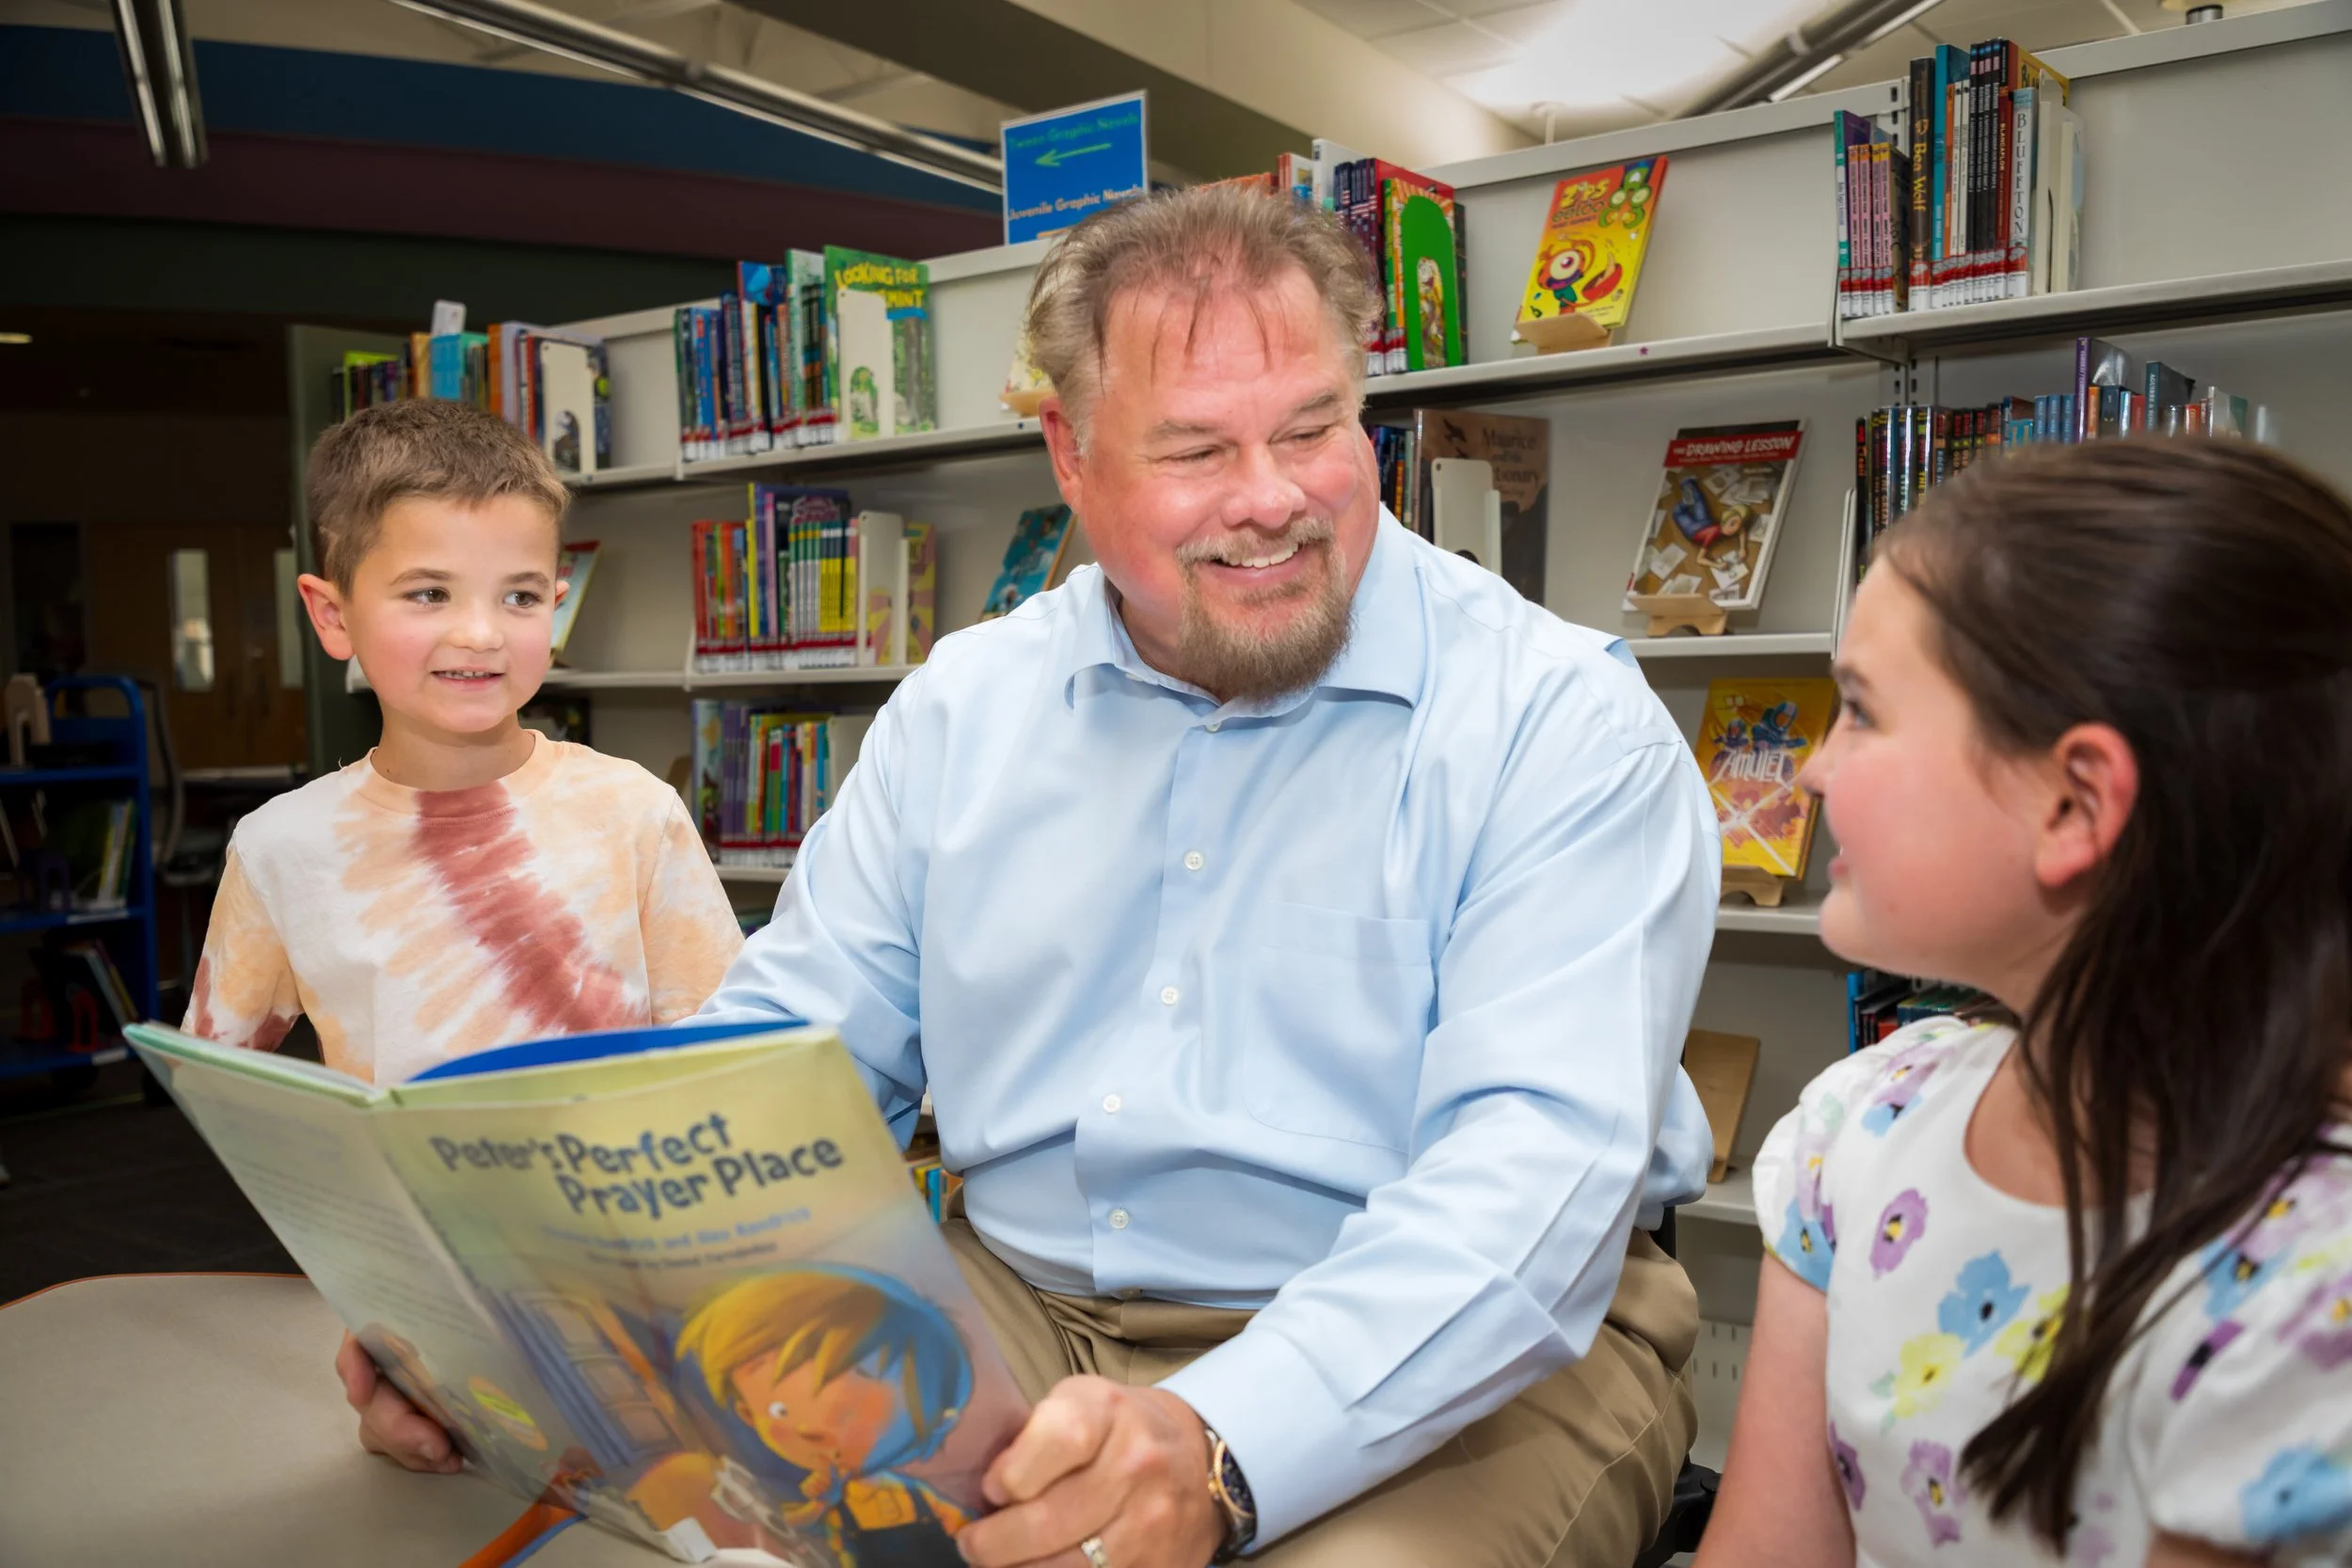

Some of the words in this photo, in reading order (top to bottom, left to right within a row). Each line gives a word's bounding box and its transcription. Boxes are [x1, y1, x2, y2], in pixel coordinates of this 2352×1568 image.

[1047, 122, 1095, 141] Graphic
[1097, 112, 1139, 130] Novels
[1914, 142, 1927, 171] Bea
[2014, 113, 2027, 234] BLUFFTON
[1009, 202, 1053, 221] Juvenile
[1055, 193, 1101, 212] Graphic
[1913, 176, 1927, 212] Wolf
[834, 261, 894, 290] LOOKING
[896, 266, 919, 284] FOR
[1686, 439, 1742, 457] DRAWING
[1744, 436, 1795, 452] LESSON
[429, 1134, 563, 1172] Peter's
[557, 1113, 731, 1175] Perfect
[555, 1172, 708, 1220] Prayer
[712, 1138, 843, 1196] Place
